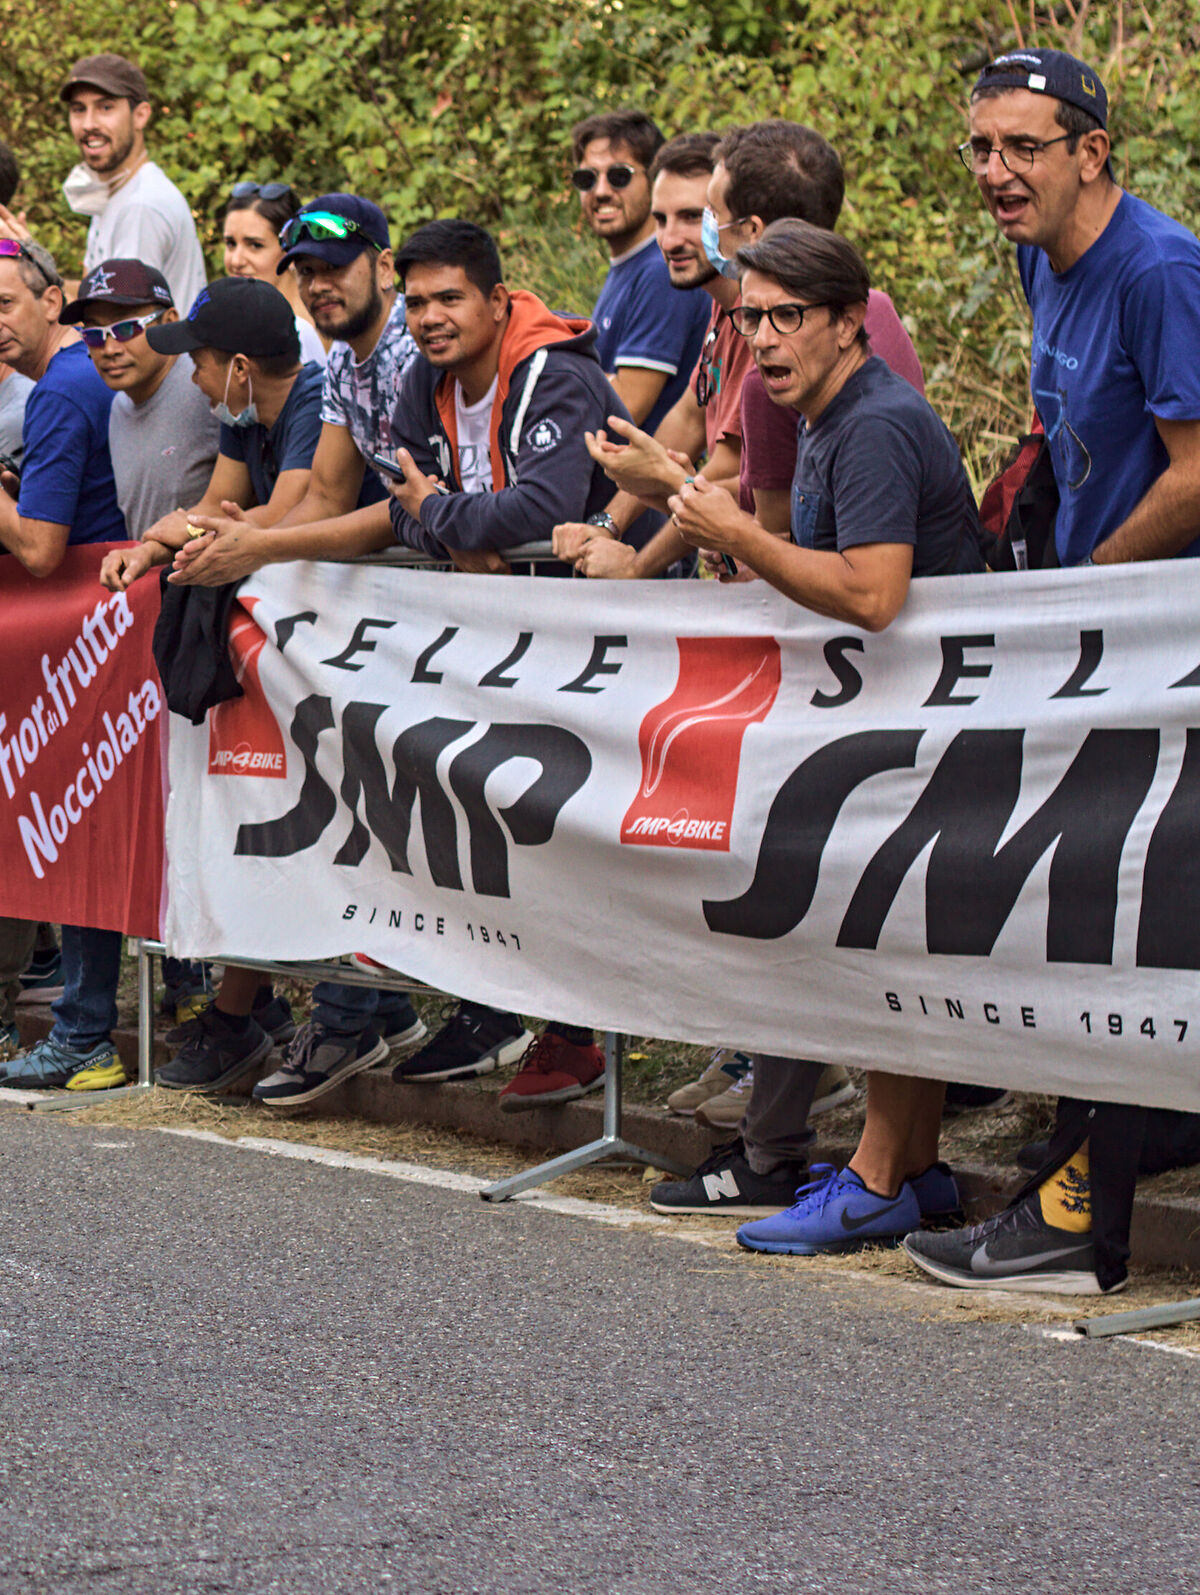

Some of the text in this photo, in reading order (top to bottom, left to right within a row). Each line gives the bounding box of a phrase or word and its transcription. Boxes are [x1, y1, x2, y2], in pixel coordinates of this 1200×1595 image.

[41, 590, 135, 727] frutta
[17, 679, 162, 879] Nocciolata
[233, 693, 593, 899] SMP
[625, 816, 727, 840] SMP4BIKE
[341, 904, 521, 951] SINCE 1947
[885, 991, 1189, 1042] SINCE 1947
